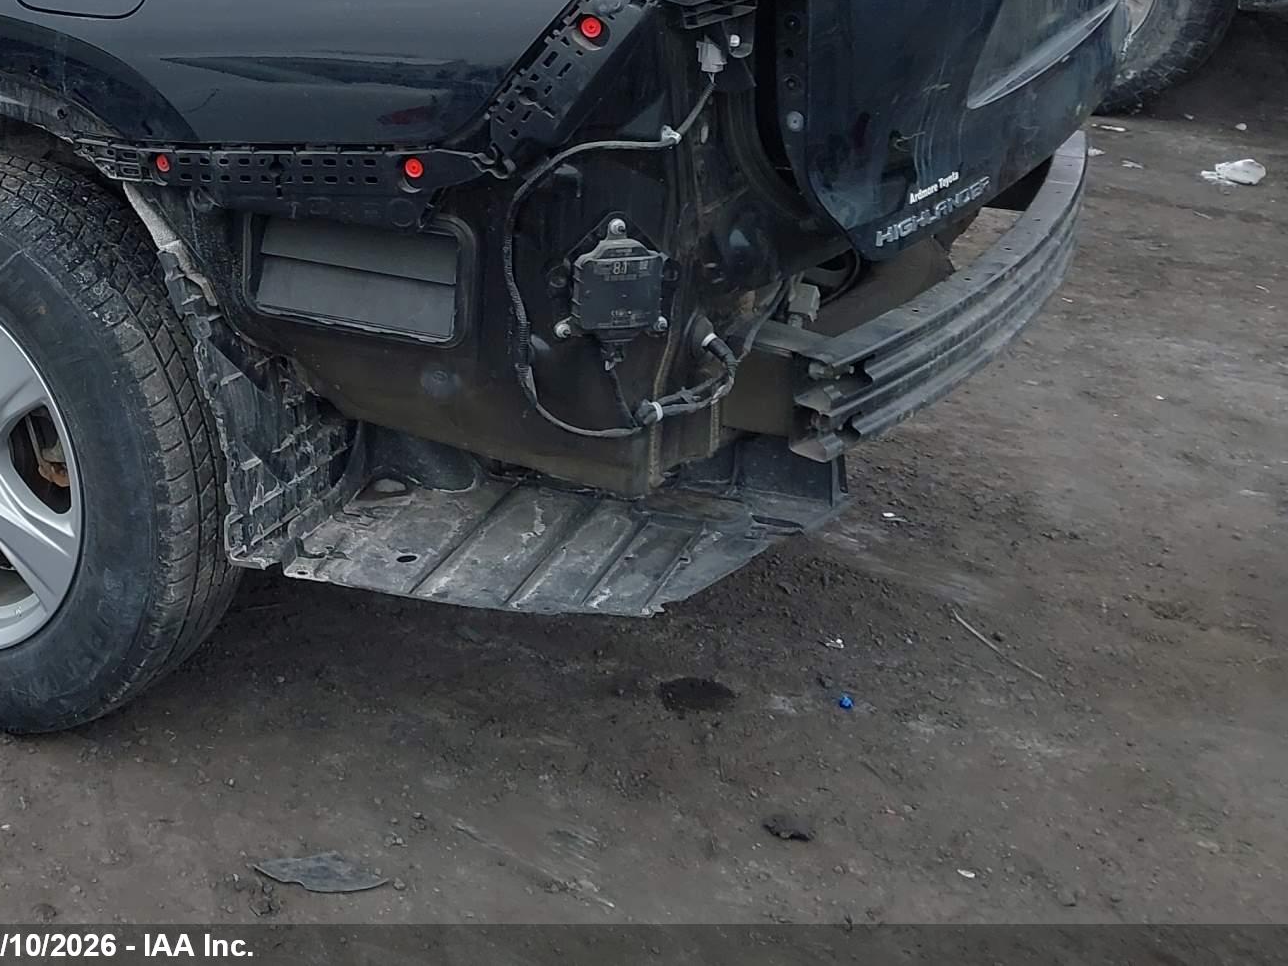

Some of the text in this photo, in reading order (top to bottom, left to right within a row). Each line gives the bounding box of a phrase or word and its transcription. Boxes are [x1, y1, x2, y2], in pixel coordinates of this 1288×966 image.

[875, 176, 990, 247] HIGHLANDER
[909, 171, 959, 204] Ardmore Toyota
